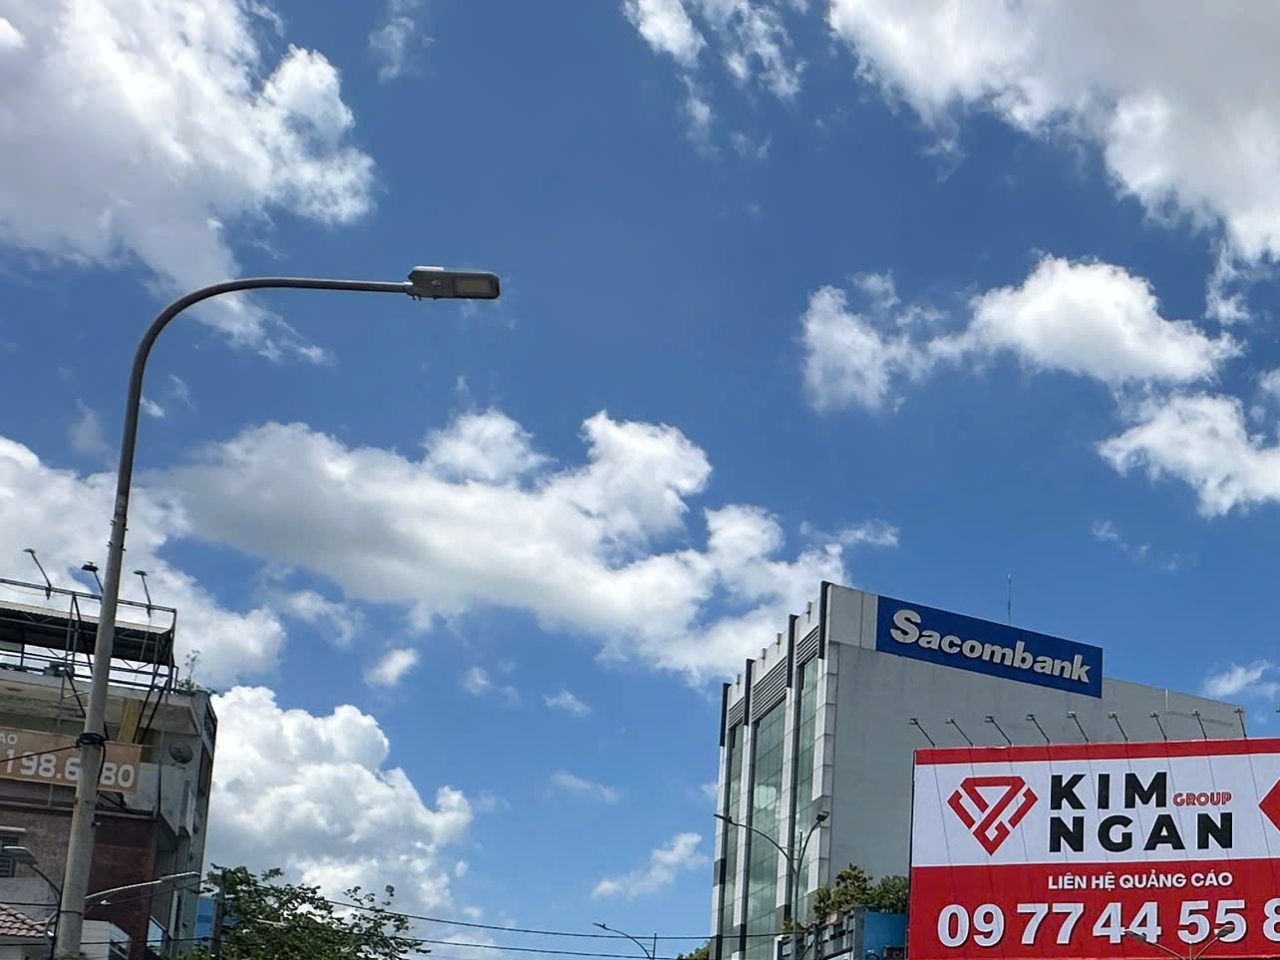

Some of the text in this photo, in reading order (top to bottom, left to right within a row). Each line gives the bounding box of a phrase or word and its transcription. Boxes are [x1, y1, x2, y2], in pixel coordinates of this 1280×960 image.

[889, 608, 1092, 683] Sacombank
[5, 749, 136, 788] 198.680
[1050, 771, 1168, 811] KIM
[1172, 791, 1233, 807] GROUP
[1049, 811, 1233, 854] NGAN
[1047, 868, 1234, 891] LIÊN HỆ QUẢNG CÁO
[937, 903, 1005, 948] 09
[1016, 902, 1085, 945] 77
[1092, 900, 1162, 944] 44
[1177, 899, 1247, 944] 55
